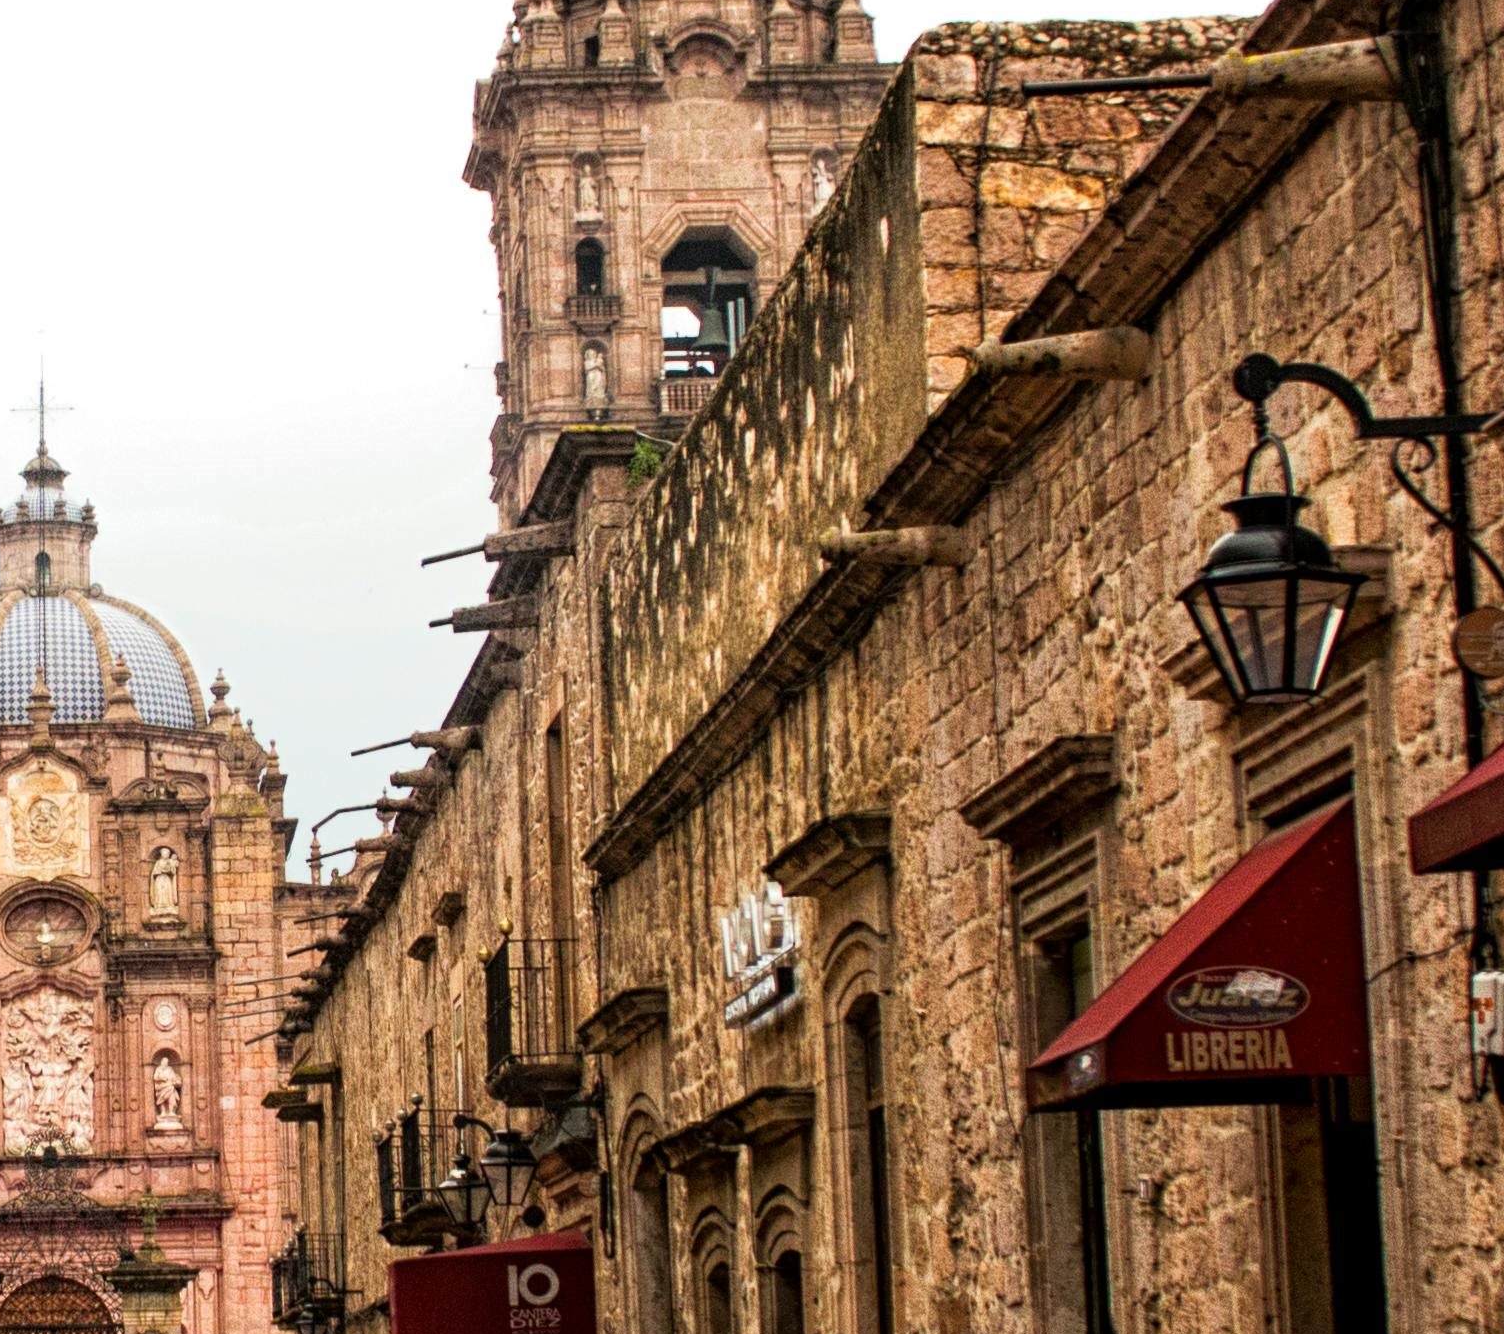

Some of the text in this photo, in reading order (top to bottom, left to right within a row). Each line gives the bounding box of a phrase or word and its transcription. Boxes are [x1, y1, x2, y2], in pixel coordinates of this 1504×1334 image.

[1164, 1028, 1294, 1073] LIBRERIA
[509, 1307, 562, 1320] CANTERA
[509, 1318, 562, 1329] DIEZ
